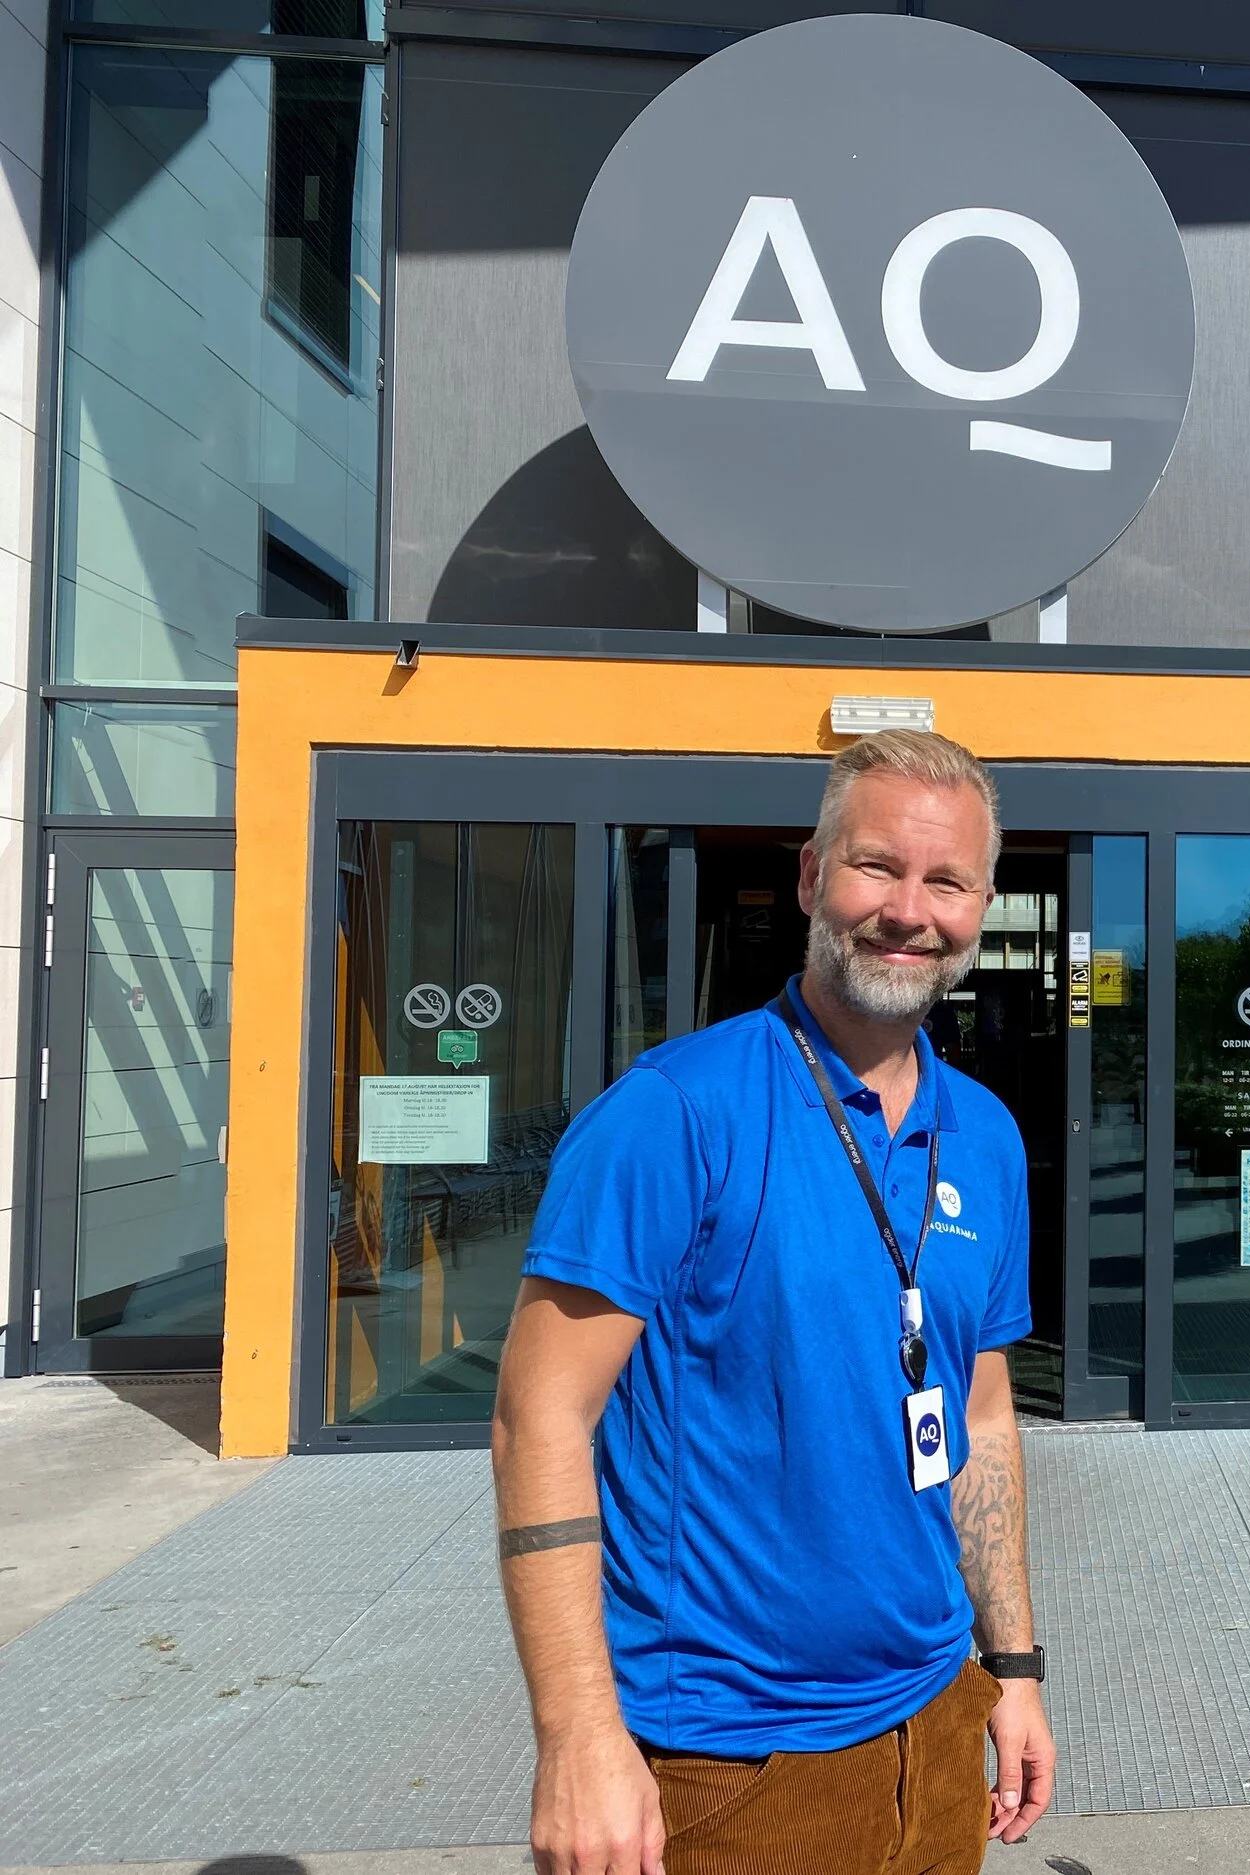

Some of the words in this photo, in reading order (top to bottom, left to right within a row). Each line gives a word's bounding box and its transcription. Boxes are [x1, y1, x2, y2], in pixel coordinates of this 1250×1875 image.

[665, 195, 1112, 471] AQ
[941, 1191, 958, 1209] AQ
[920, 1424, 939, 1443] AQ
